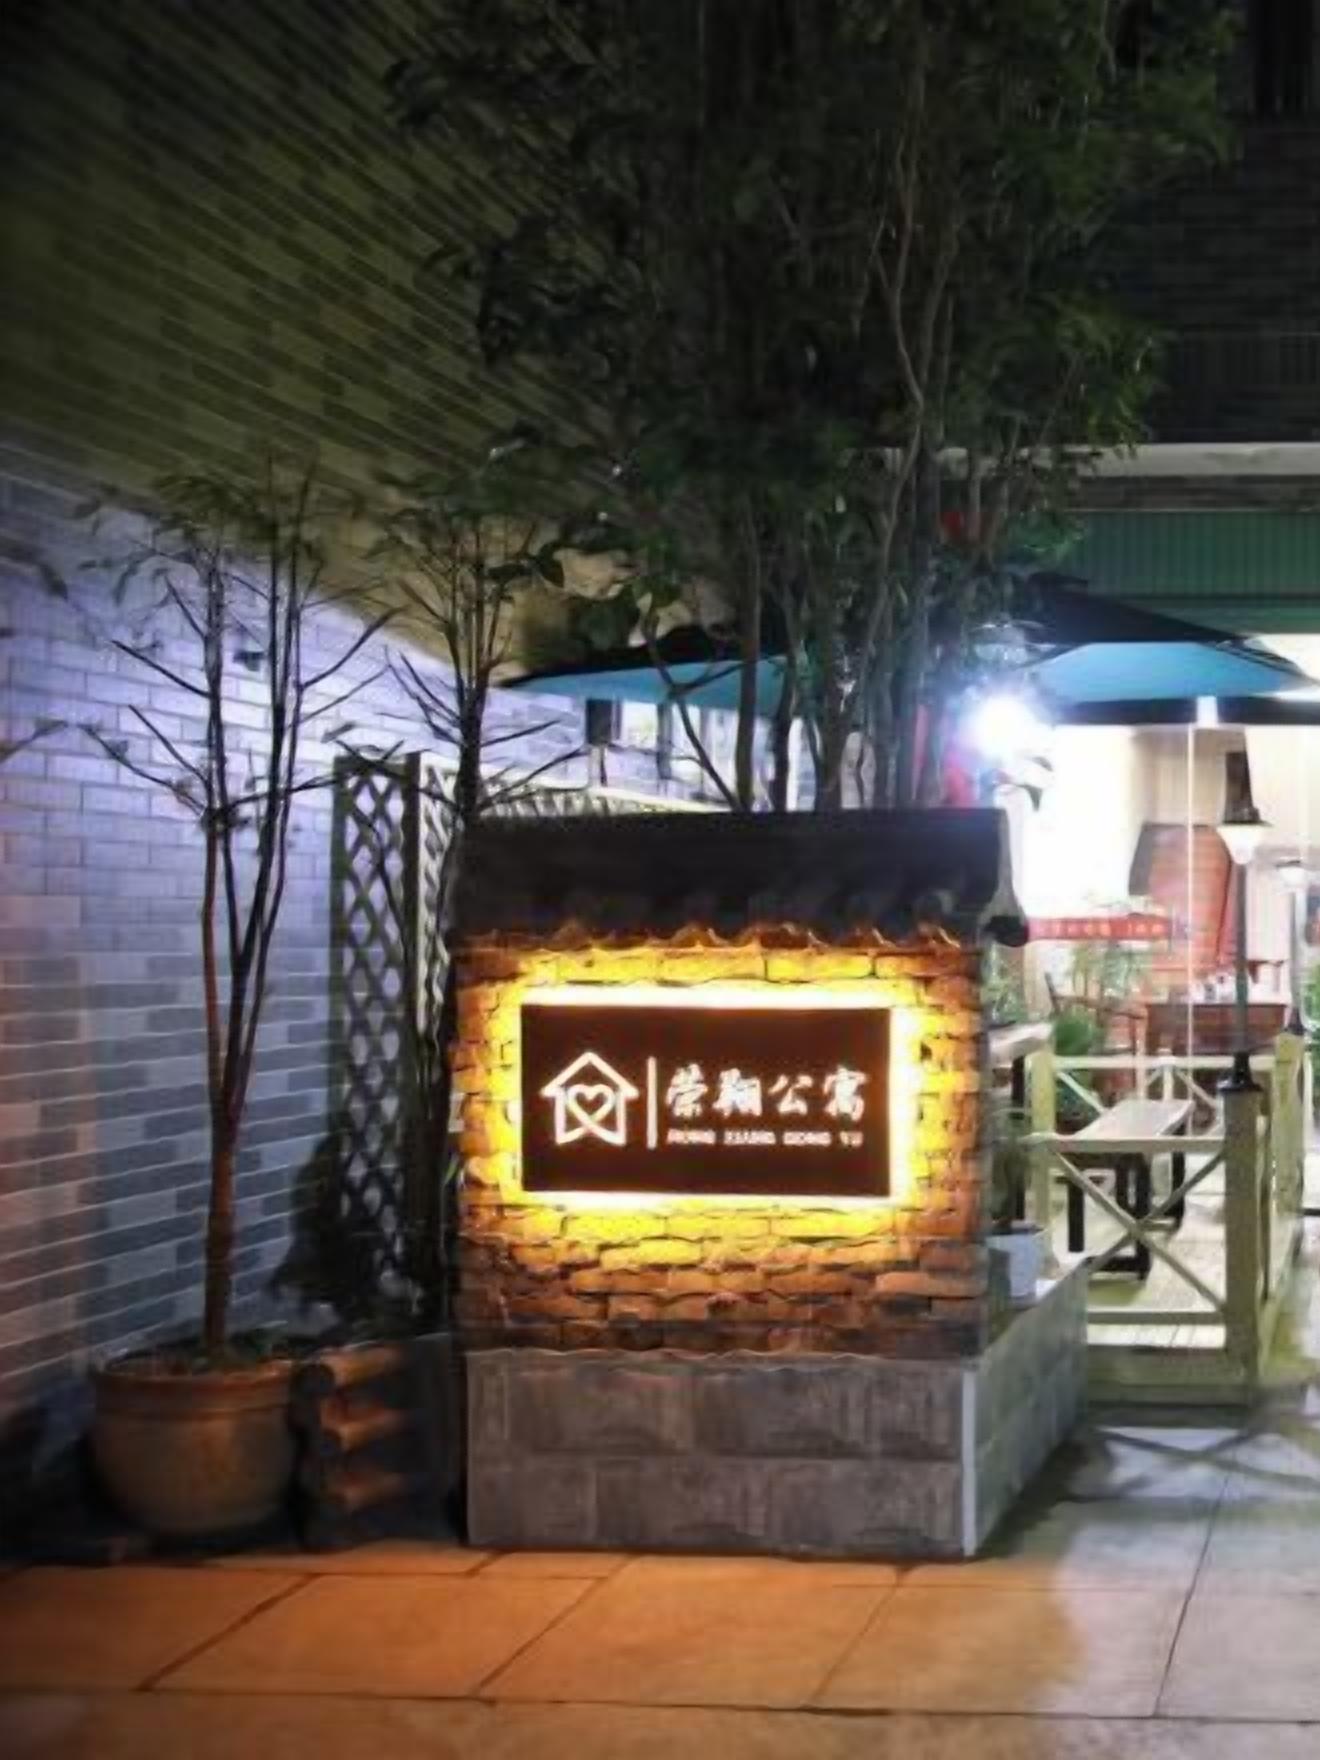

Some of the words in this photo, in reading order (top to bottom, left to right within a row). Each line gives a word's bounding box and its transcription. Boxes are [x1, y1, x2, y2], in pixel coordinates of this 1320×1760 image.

[666, 1064, 867, 1121] 荣翔公寓
[724, 1130, 776, 1146] XIANG
[839, 1131, 863, 1147] YU
